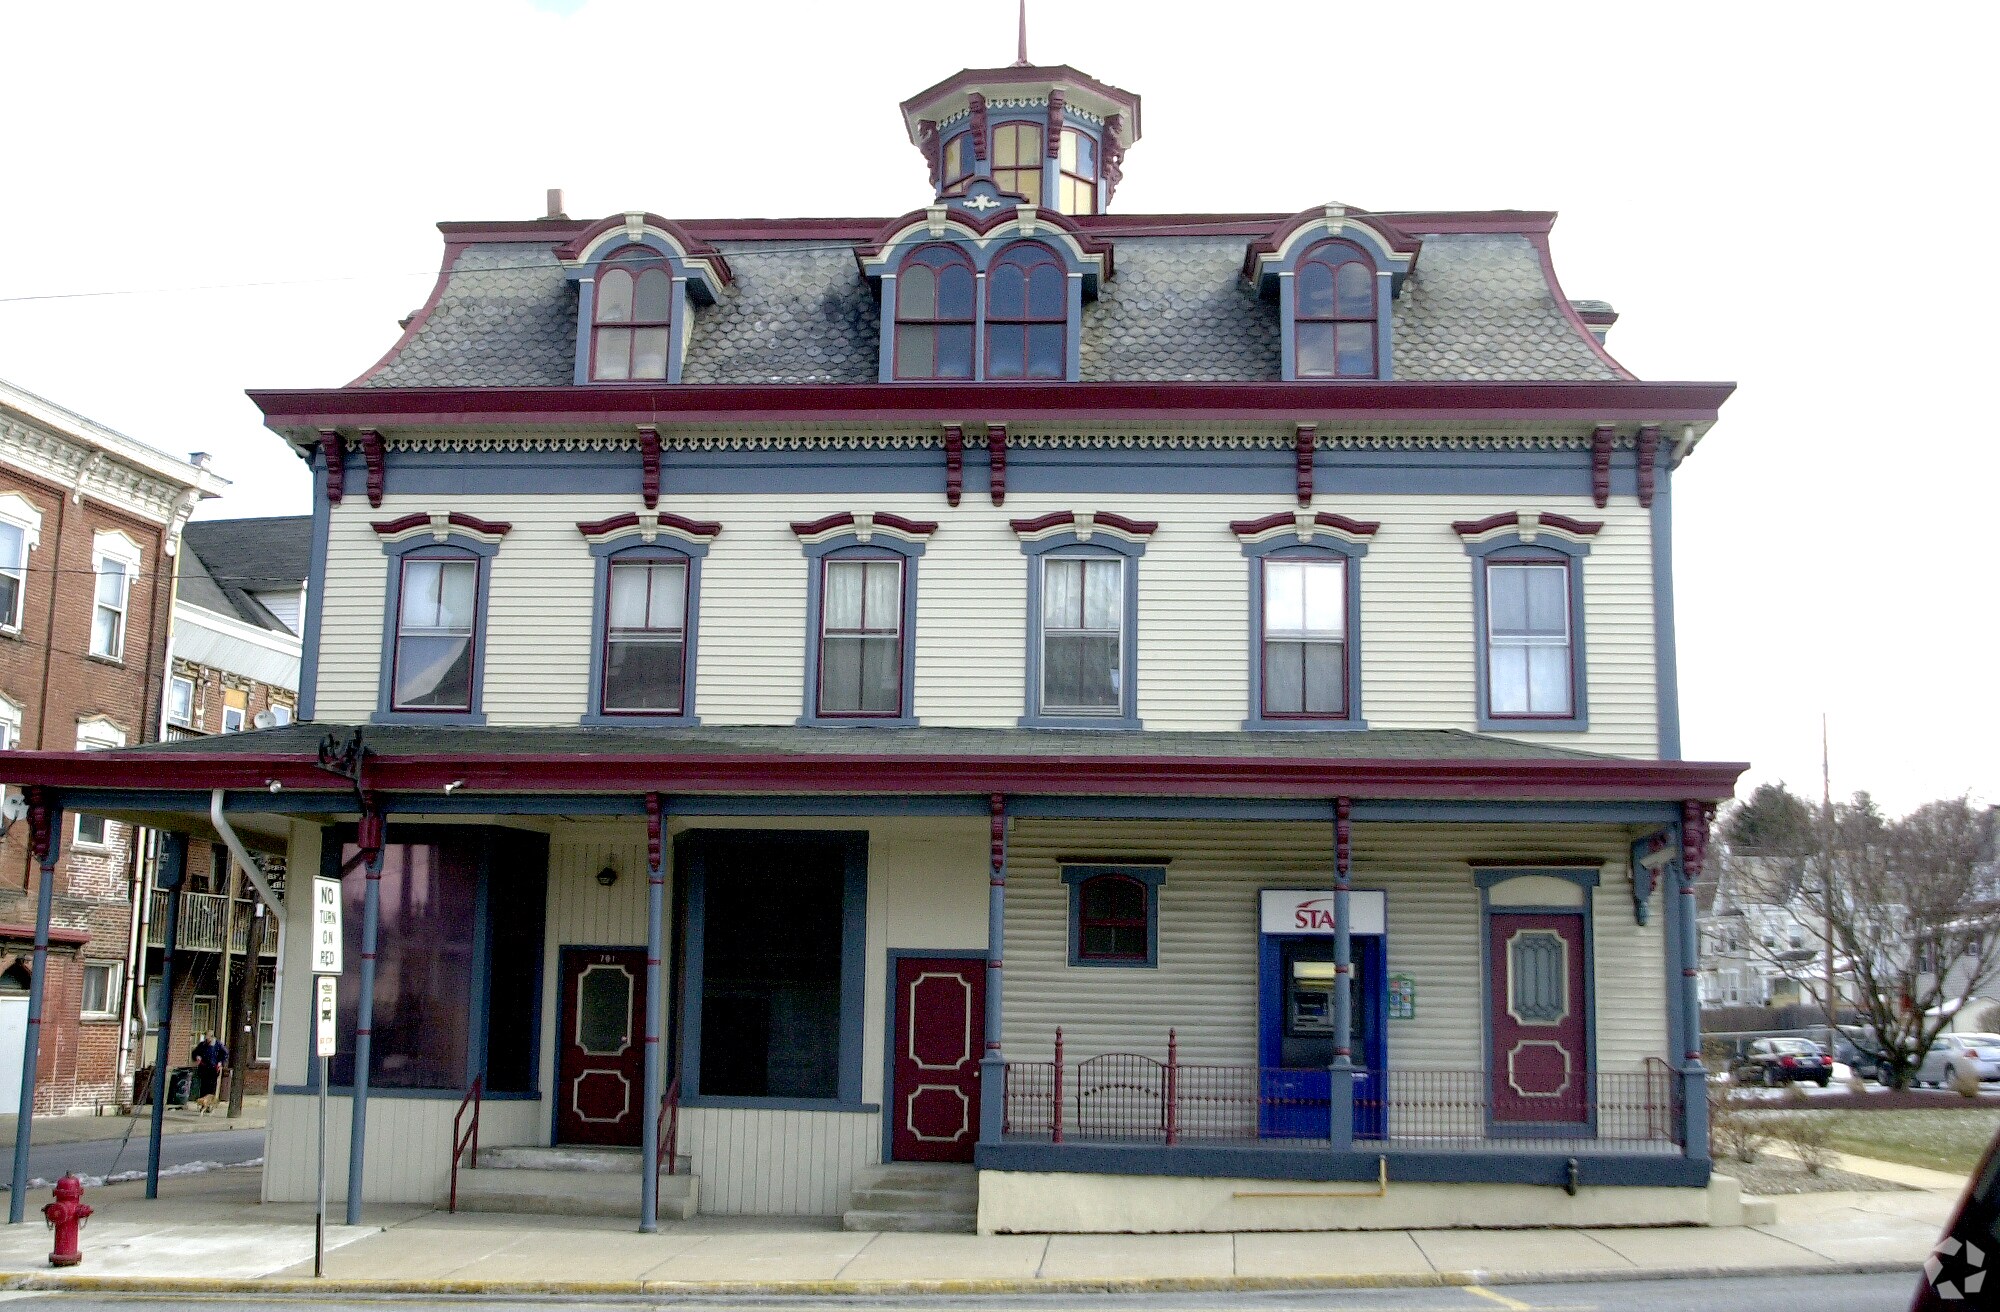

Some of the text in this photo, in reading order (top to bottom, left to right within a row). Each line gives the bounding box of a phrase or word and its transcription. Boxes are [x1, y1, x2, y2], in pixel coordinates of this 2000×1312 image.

[321, 886, 334, 905] NO
[319, 909, 337, 925] TURN
[1295, 909, 1354, 929] STA
[322, 929, 333, 945] ON
[320, 950, 335, 967] RED
